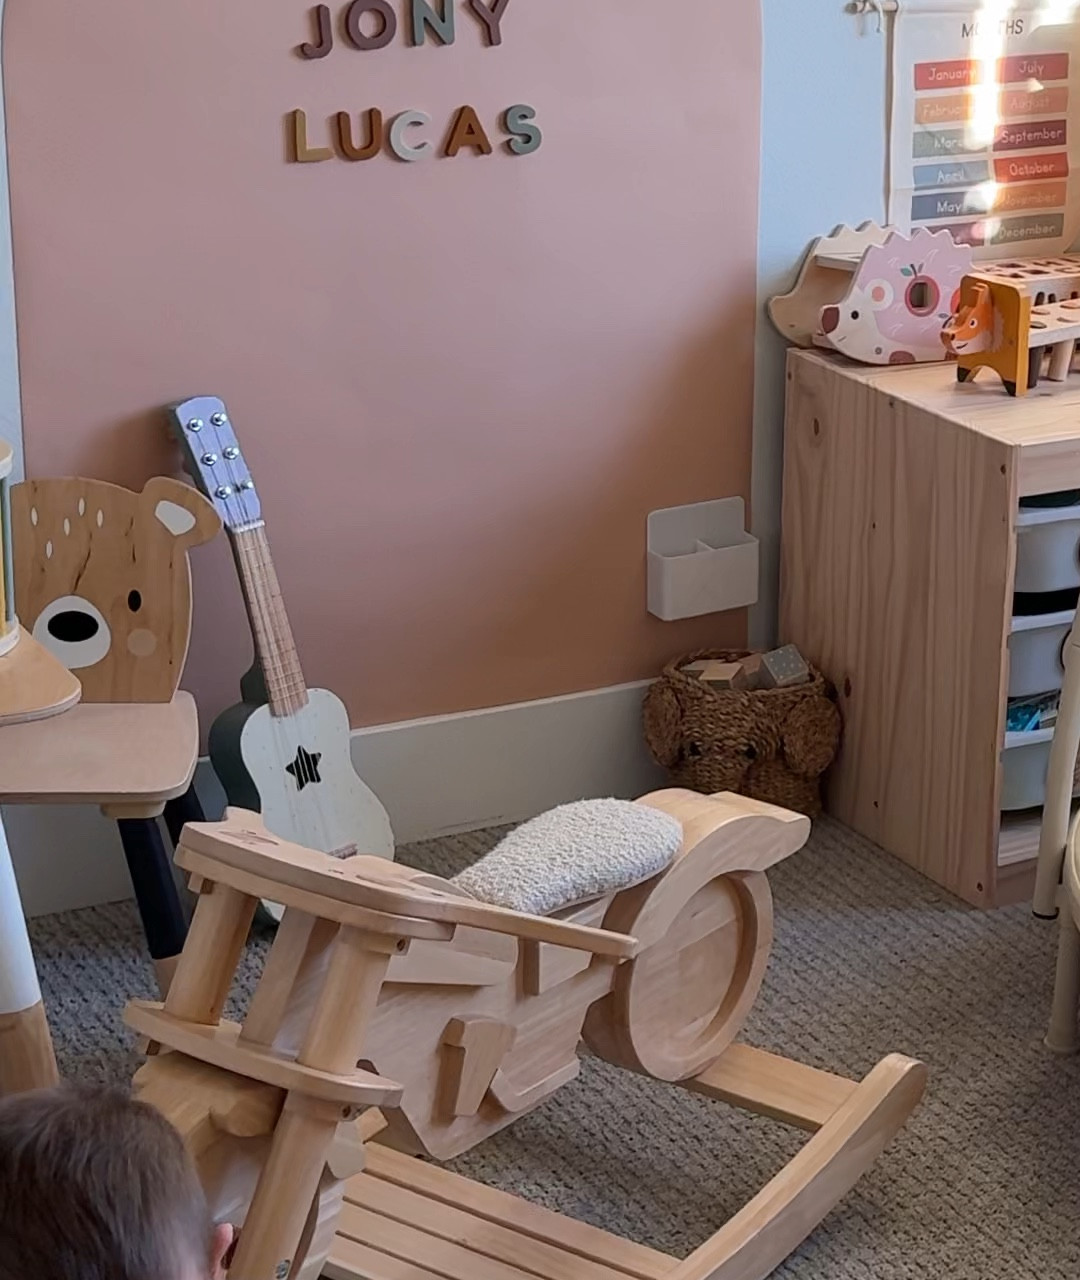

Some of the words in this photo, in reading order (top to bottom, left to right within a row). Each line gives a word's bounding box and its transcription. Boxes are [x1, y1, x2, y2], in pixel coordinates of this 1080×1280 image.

[1019, 60, 1045, 75] July
[293, 103, 543, 163] LUCAS
[1001, 127, 1063, 144] September
[1009, 162, 1055, 176] October
[937, 200, 962, 215] May
[998, 224, 1055, 239] December
